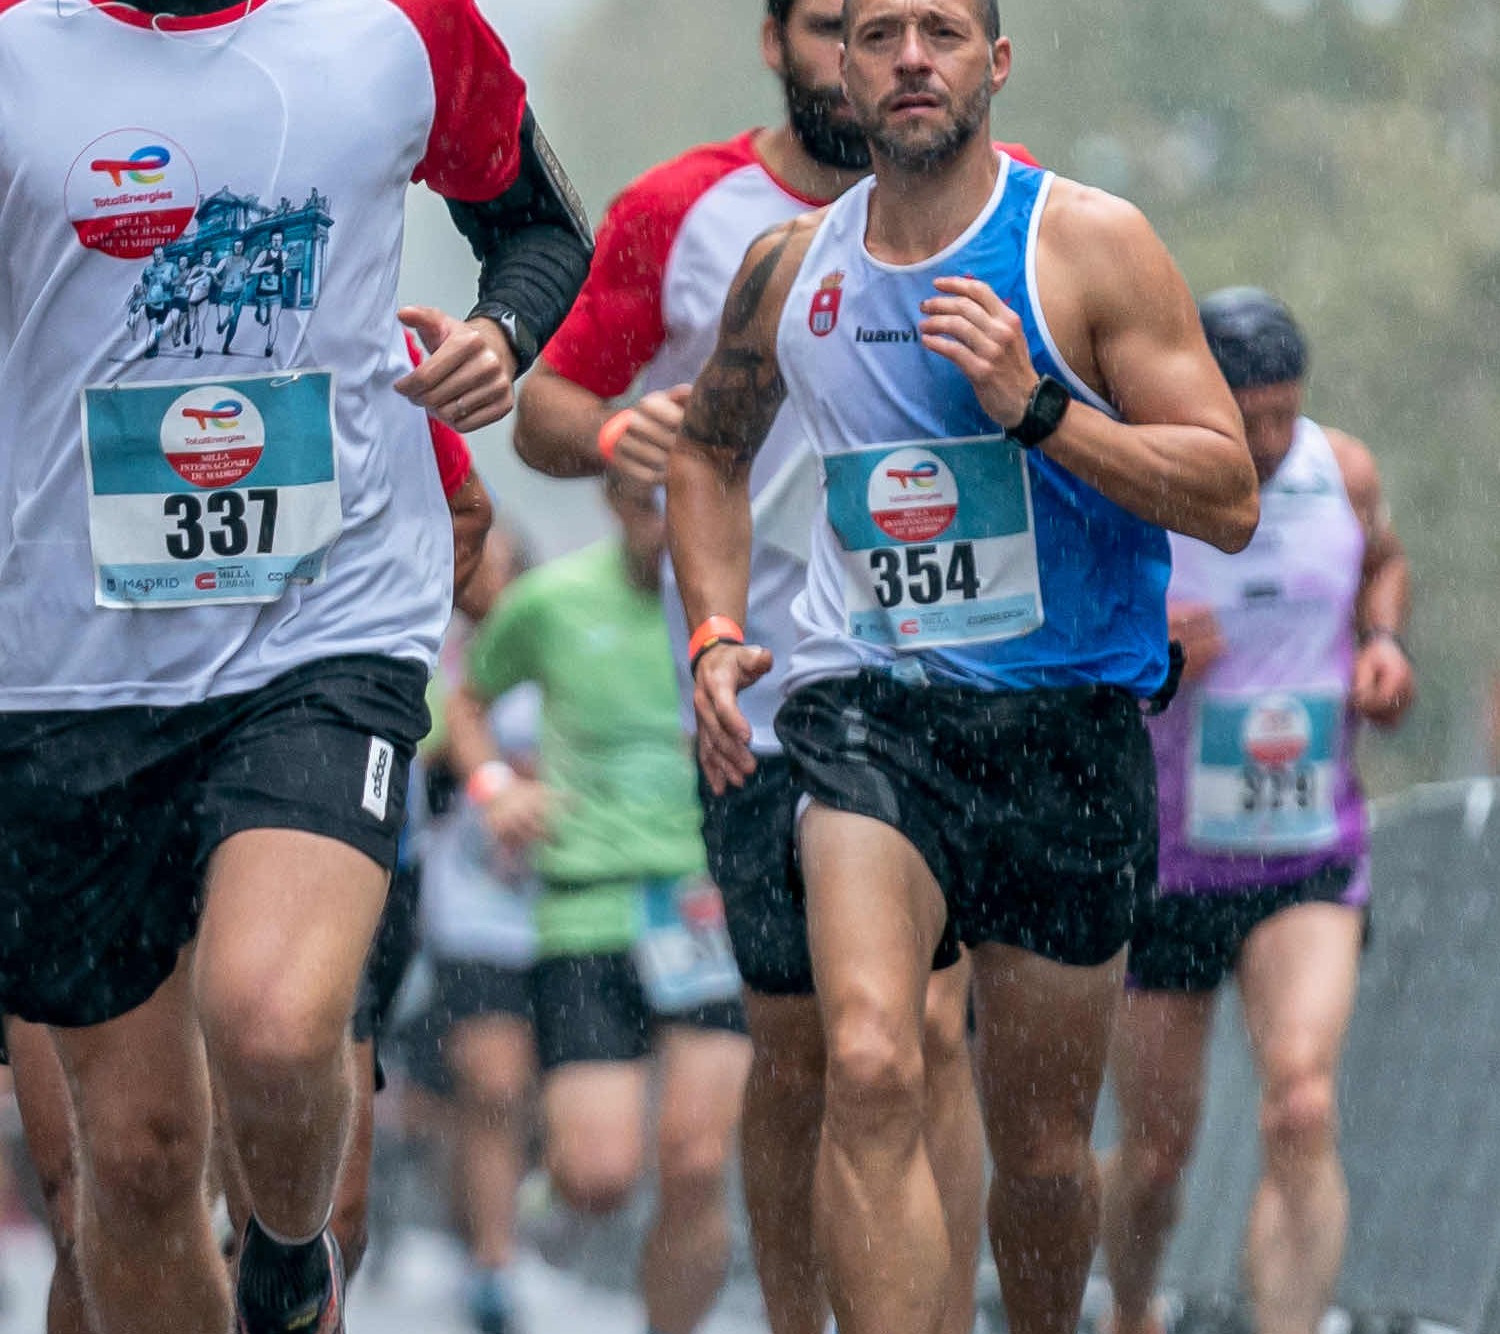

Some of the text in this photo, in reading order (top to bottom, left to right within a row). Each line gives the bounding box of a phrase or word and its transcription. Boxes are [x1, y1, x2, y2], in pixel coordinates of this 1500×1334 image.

[92, 190, 173, 208] TotalEnergies
[200, 453, 230, 462] MILLA
[164, 488, 279, 560] 337
[122, 577, 180, 590] MADRID
[870, 541, 981, 608] 354
[371, 747, 389, 800] adidas
